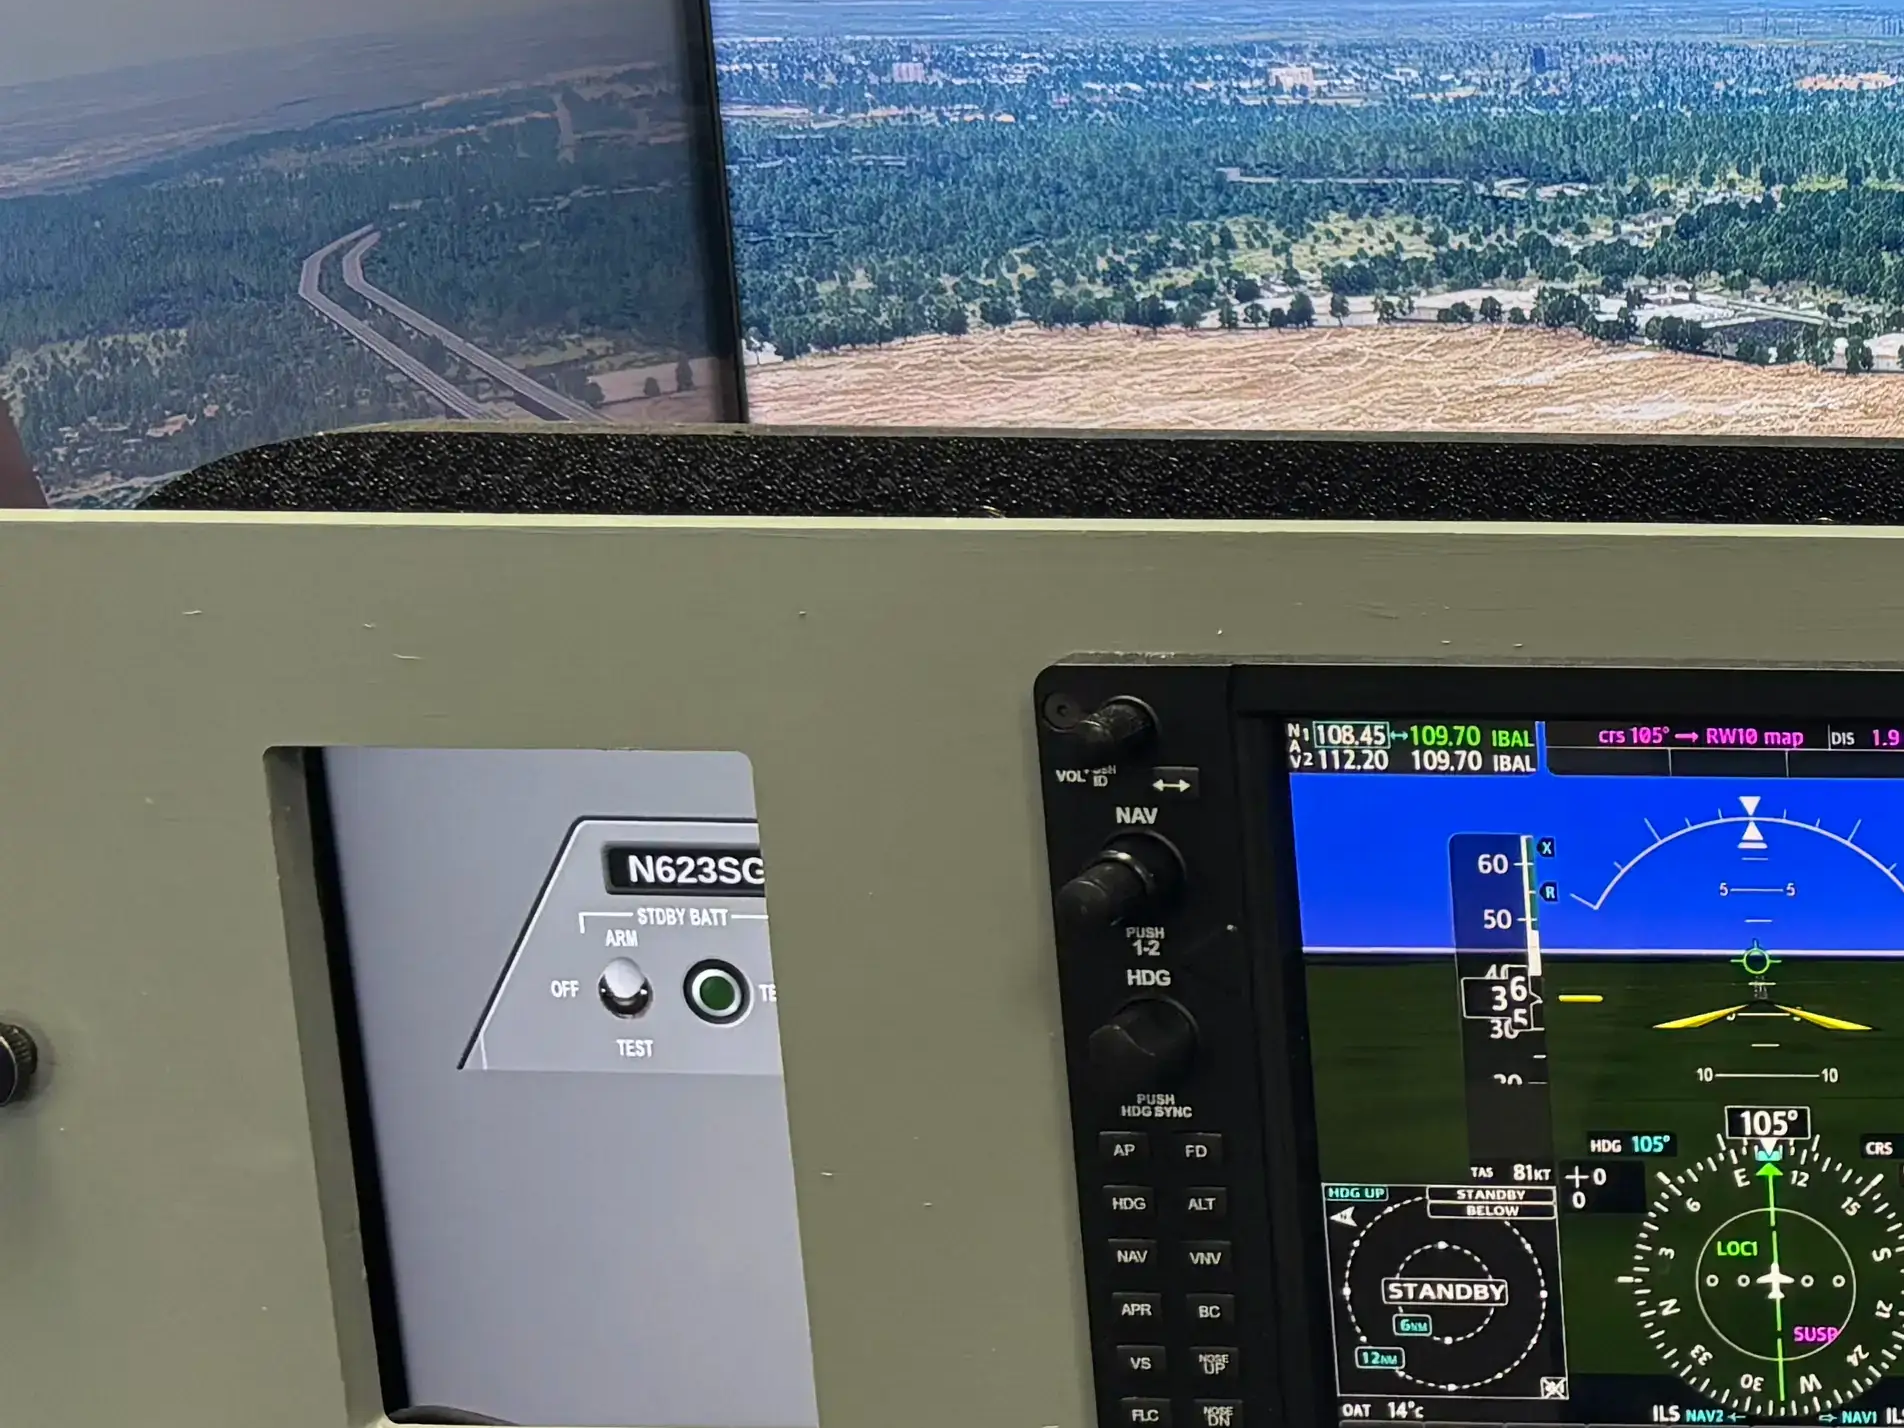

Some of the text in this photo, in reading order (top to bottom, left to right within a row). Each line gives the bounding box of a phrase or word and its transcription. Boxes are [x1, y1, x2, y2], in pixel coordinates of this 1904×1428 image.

[1316, 726, 1532, 746] 108.45 109.70 IBAL
[1599, 730, 1628, 743] crs
[1706, 728, 1758, 745] RW10
[1764, 730, 1803, 748] map
[1319, 751, 1535, 771] 112.20 109.70 IBAL
[1116, 807, 1158, 824] NAV
[638, 908, 728, 926] STDBY BATT
[606, 930, 638, 946] ARM
[1127, 970, 1171, 987] HDG
[551, 980, 579, 997] OFF
[617, 1039, 653, 1057] TEST
[1113, 1144, 1135, 1158] AP
[1457, 1190, 1526, 1201] STANDBY
[1467, 1206, 1519, 1217] BELOW
[1388, 1283, 1504, 1301] STANDBY
[1130, 1356, 1151, 1370] VS
